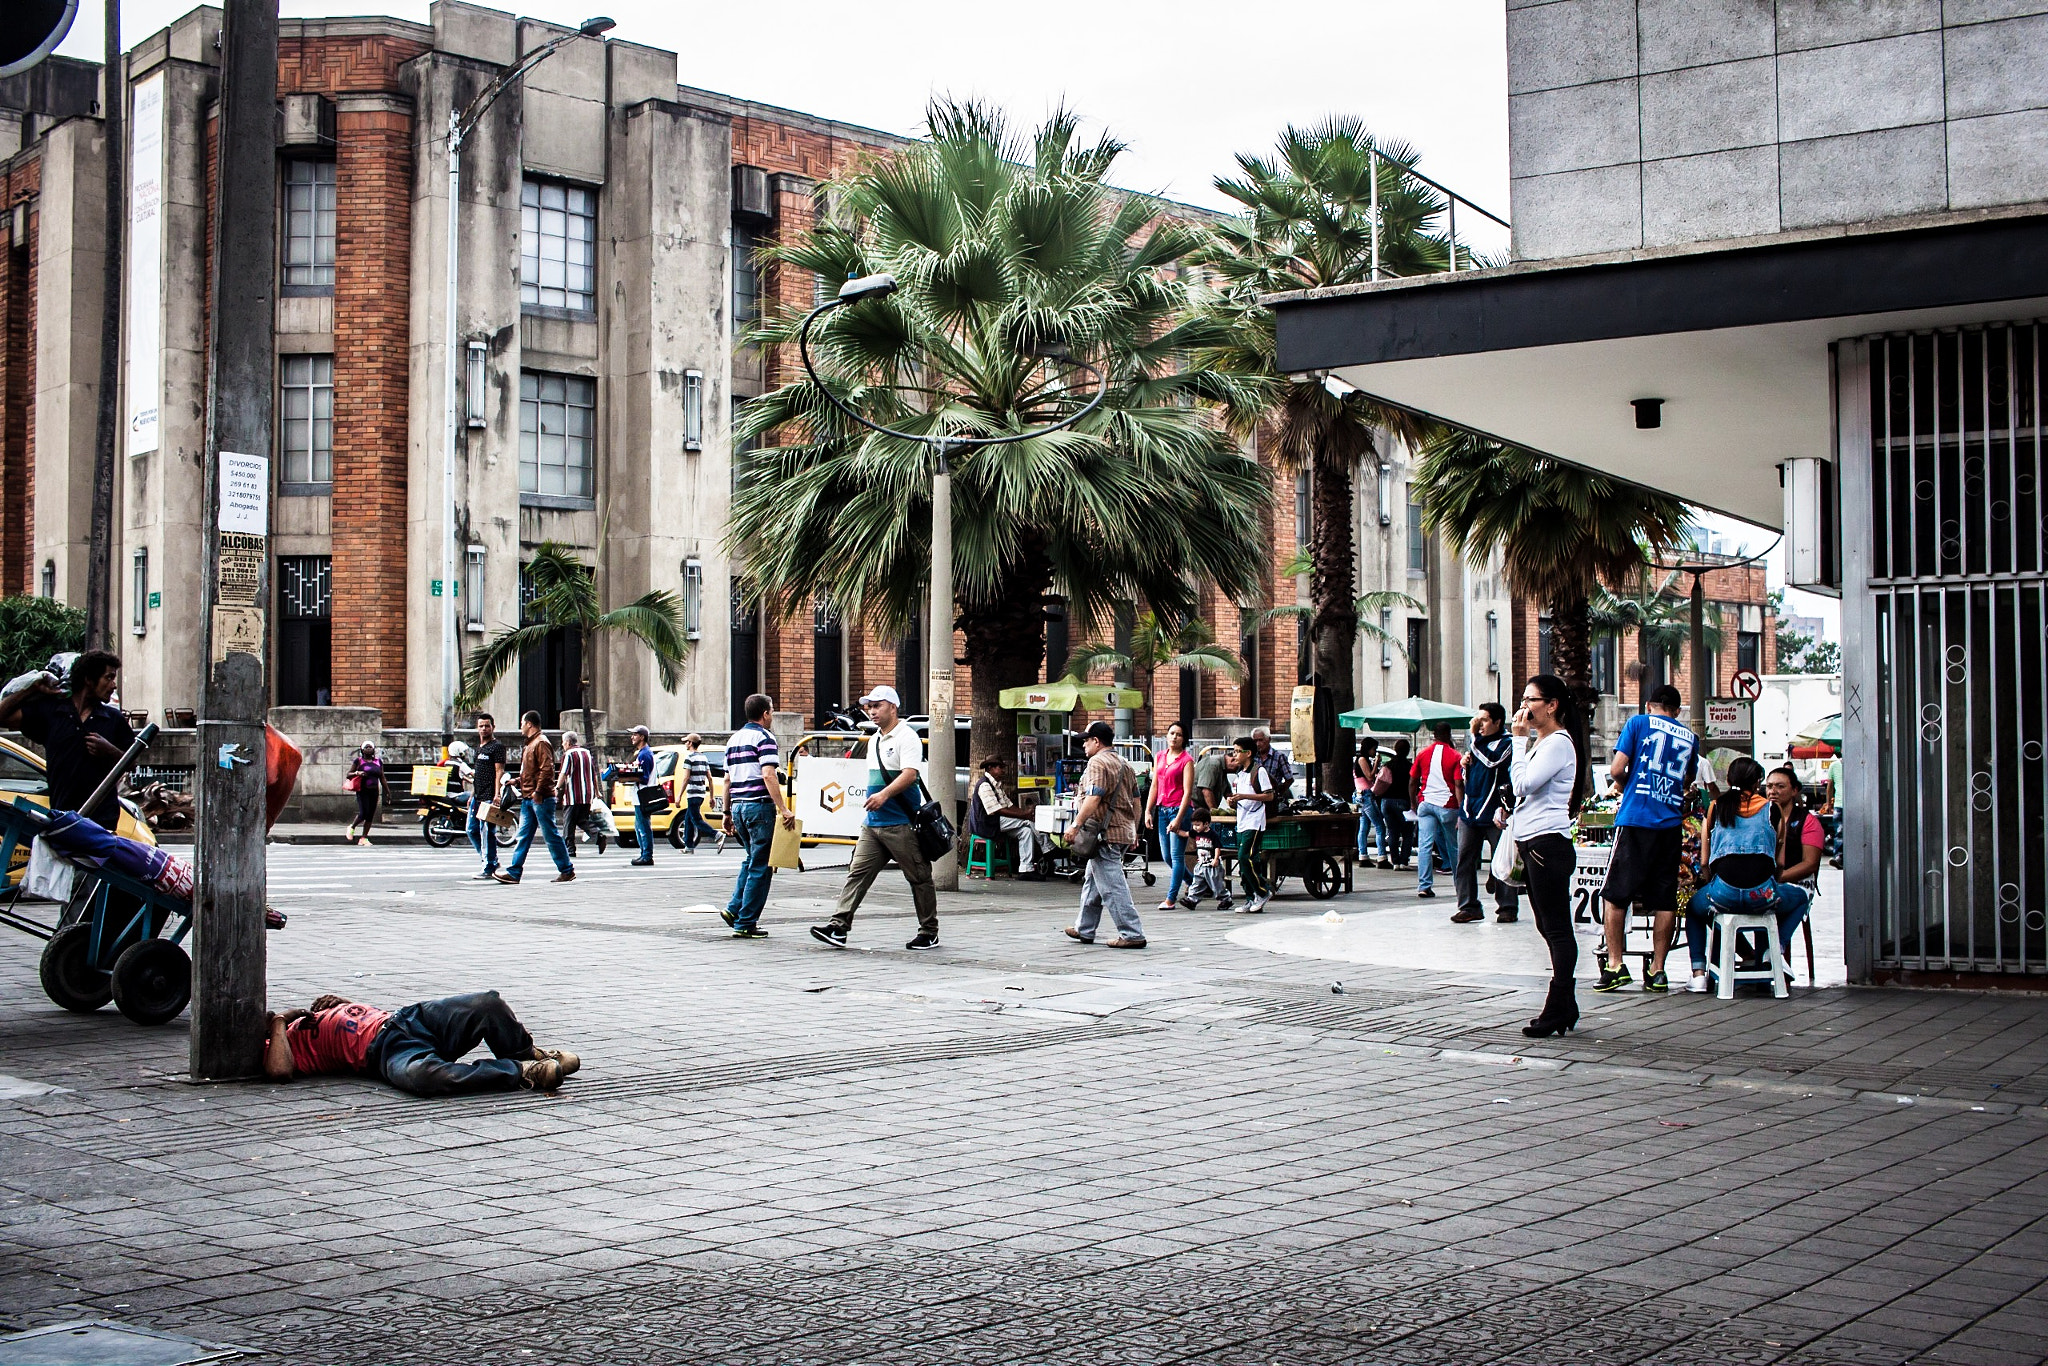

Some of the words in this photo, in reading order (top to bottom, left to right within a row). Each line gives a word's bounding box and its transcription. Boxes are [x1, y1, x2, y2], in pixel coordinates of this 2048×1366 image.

[229, 460, 262, 470] DIVORCIOS
[229, 502, 259, 511] Abogados
[221, 535, 264, 551] ALCOBAS
[1709, 713, 1737, 722] Tejelo
[1652, 719, 1665, 729] OFF
[1648, 731, 1692, 781] 13
